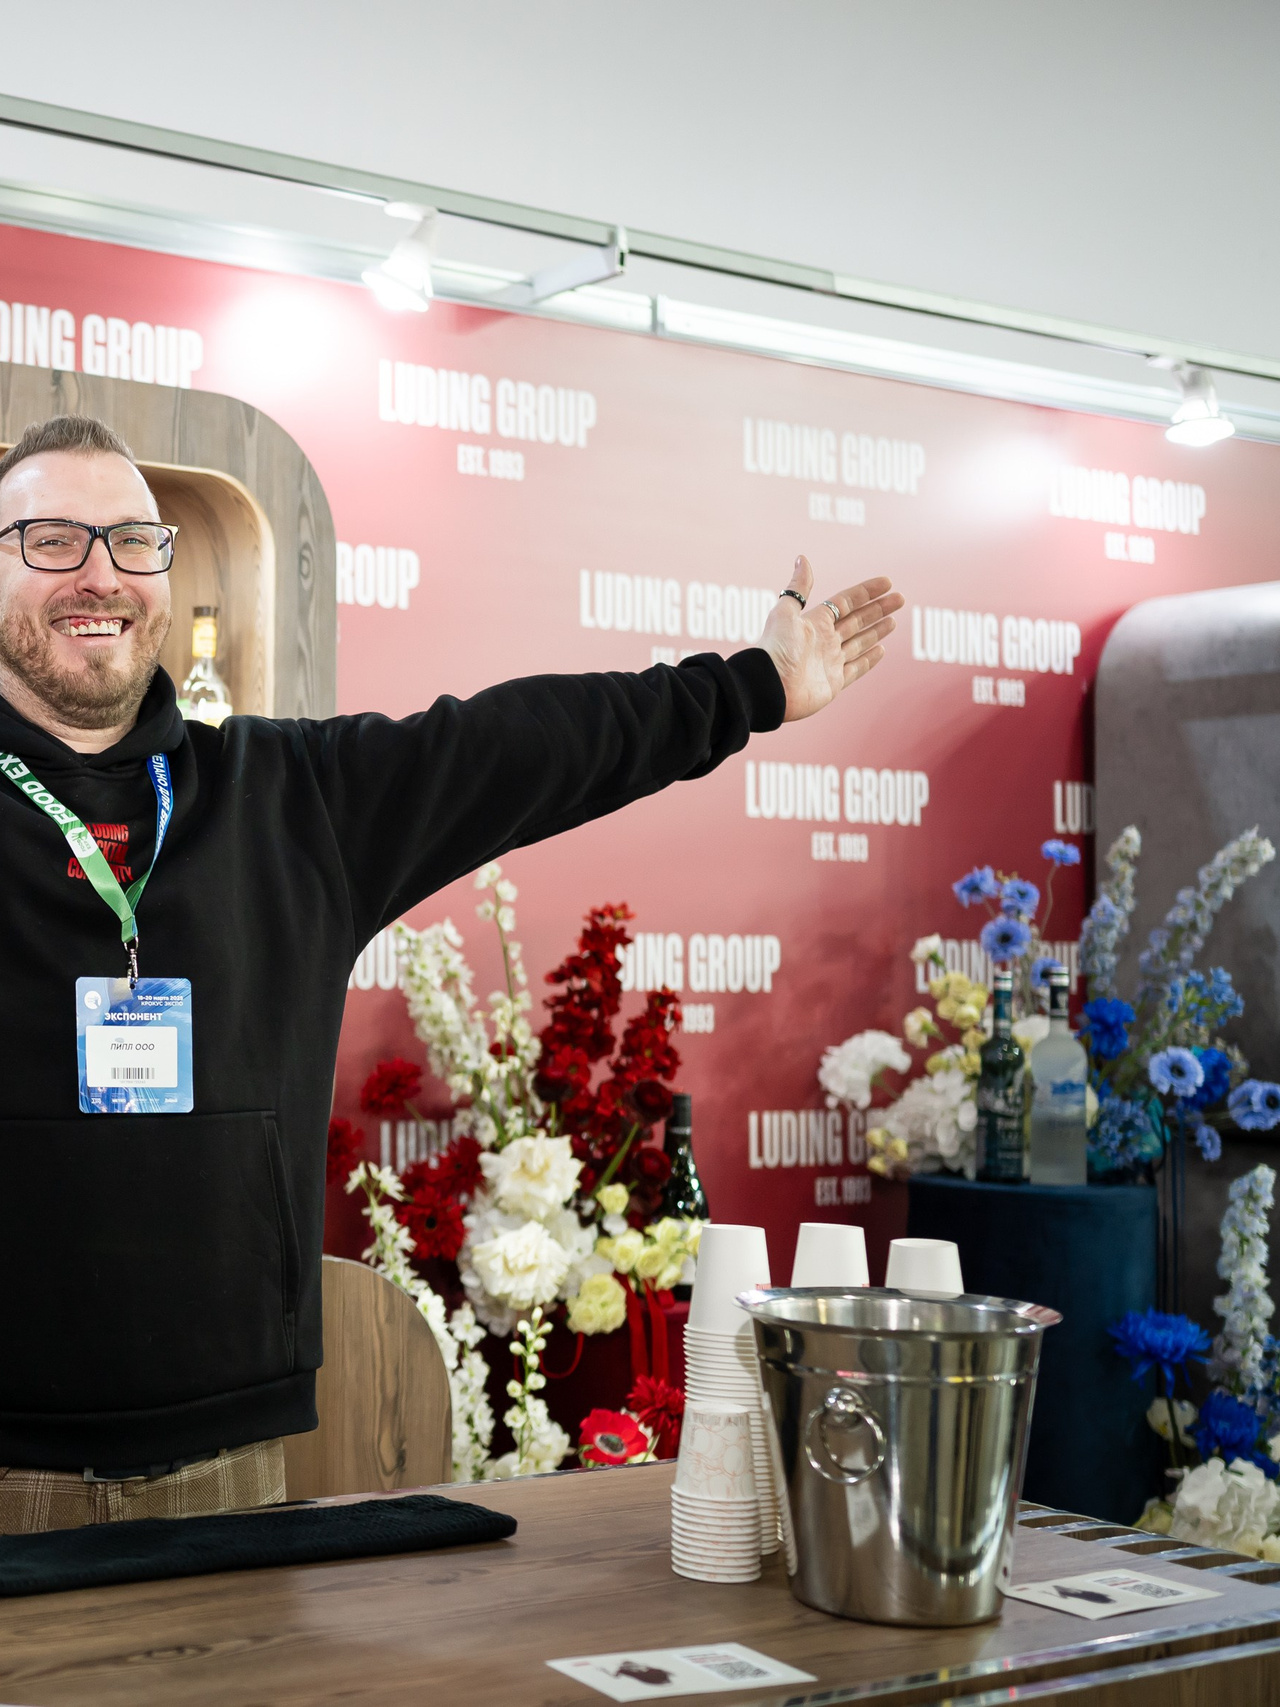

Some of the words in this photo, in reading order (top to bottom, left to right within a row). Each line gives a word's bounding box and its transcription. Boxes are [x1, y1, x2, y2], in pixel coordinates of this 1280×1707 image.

[82, 314, 203, 389] GROUP
[378, 358, 491, 435] LUDING
[496, 377, 597, 449] GROUP
[457, 443, 488, 477] EST.
[743, 416, 837, 484] LUDING
[842, 431, 926, 496] GROUP
[1049, 464, 1131, 526] LUDING
[1132, 475, 1207, 536] GROUP
[335, 541, 420, 611] ROUP
[579, 568, 682, 637] LUDING
[912, 605, 999, 668] LUDING
[1002, 614, 1081, 675] GROUP
[973, 675, 997, 704] EST.
[22, 781, 80, 825] FOOD
[746, 760, 840, 823] LUDING
[844, 765, 930, 827] GROUP
[811, 831, 837, 862] EST.
[838, 833, 869, 863] 1993
[688, 933, 781, 994] GROUP
[104, 1012, 163, 1021] ЭКСПОНЕНТ
[110, 1043, 133, 1051] ПИПЛ
[748, 1110, 843, 1169] LUDING
